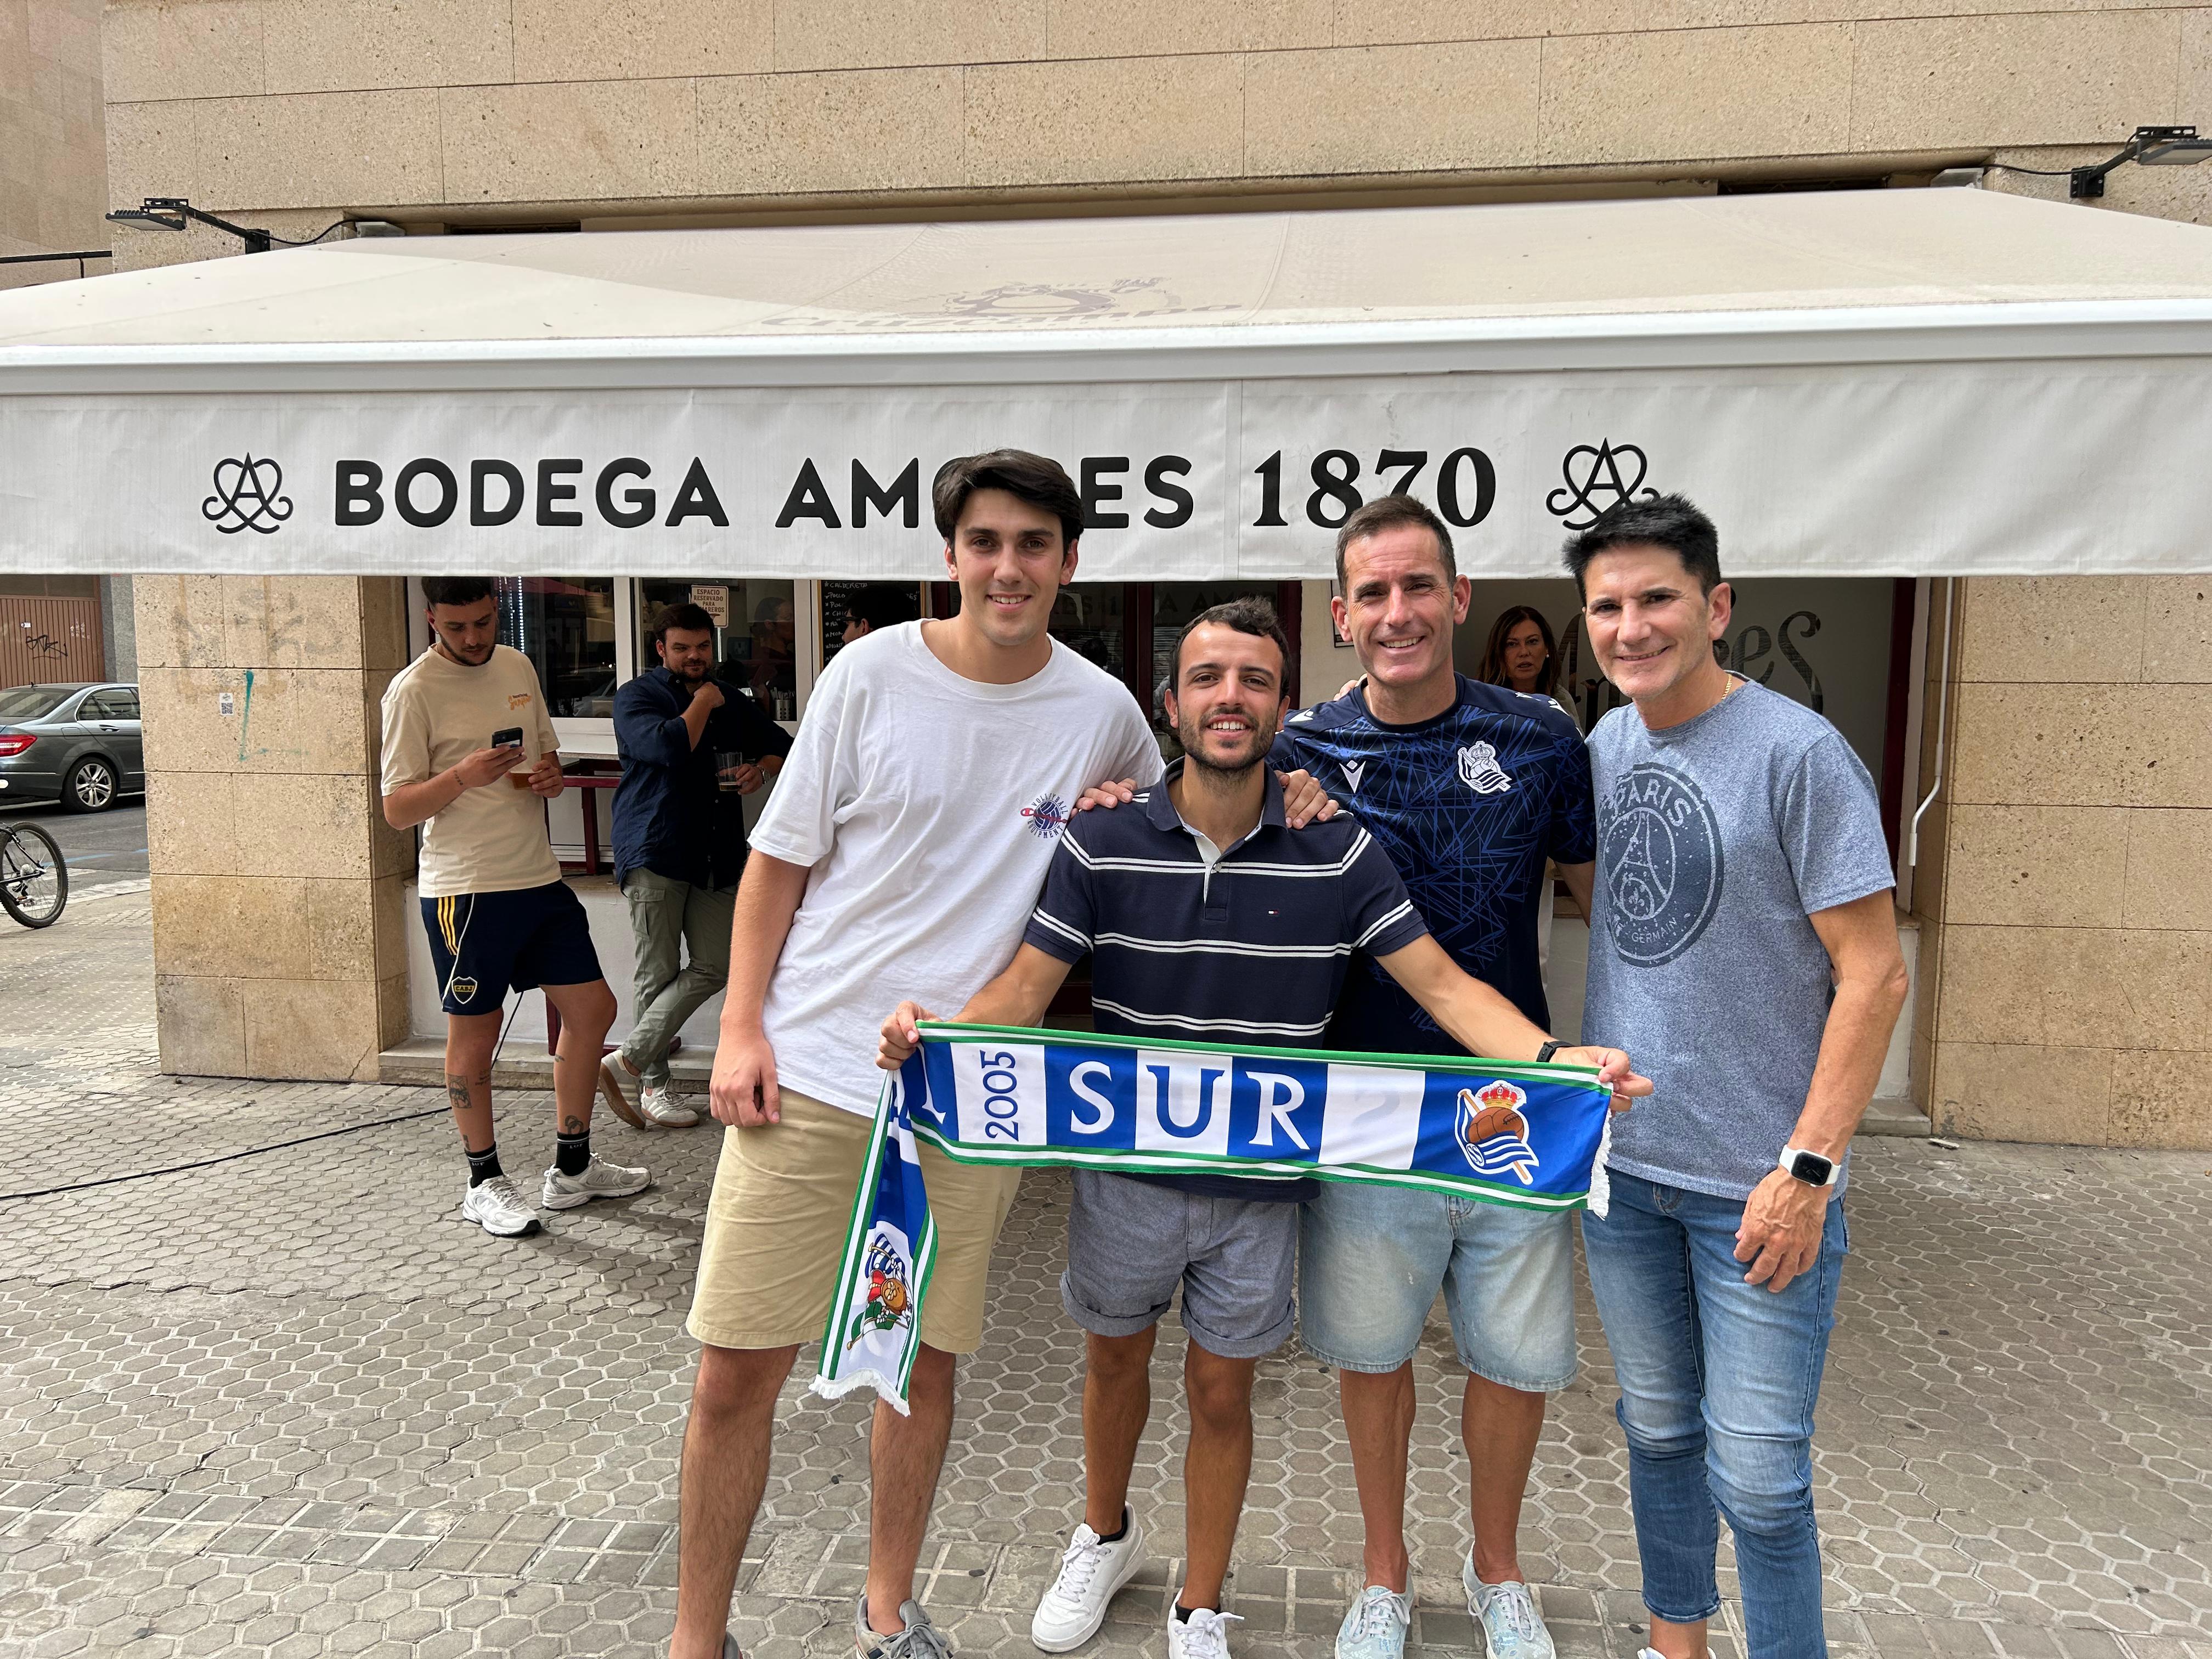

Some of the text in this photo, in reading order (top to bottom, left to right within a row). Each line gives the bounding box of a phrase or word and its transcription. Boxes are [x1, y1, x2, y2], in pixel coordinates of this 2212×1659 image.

[335, 447, 1496, 528] BODEGA AMES 1870
[1031, 793, 1069, 814] VOLLEYBALL
[1614, 778, 1690, 826] PARIS
[1027, 820, 1063, 839] EQUIPMENT
[1631, 917, 1677, 944] GERMAIN
[980, 1049, 1019, 1142] 2005
[1069, 1060, 1311, 1150] SUR
